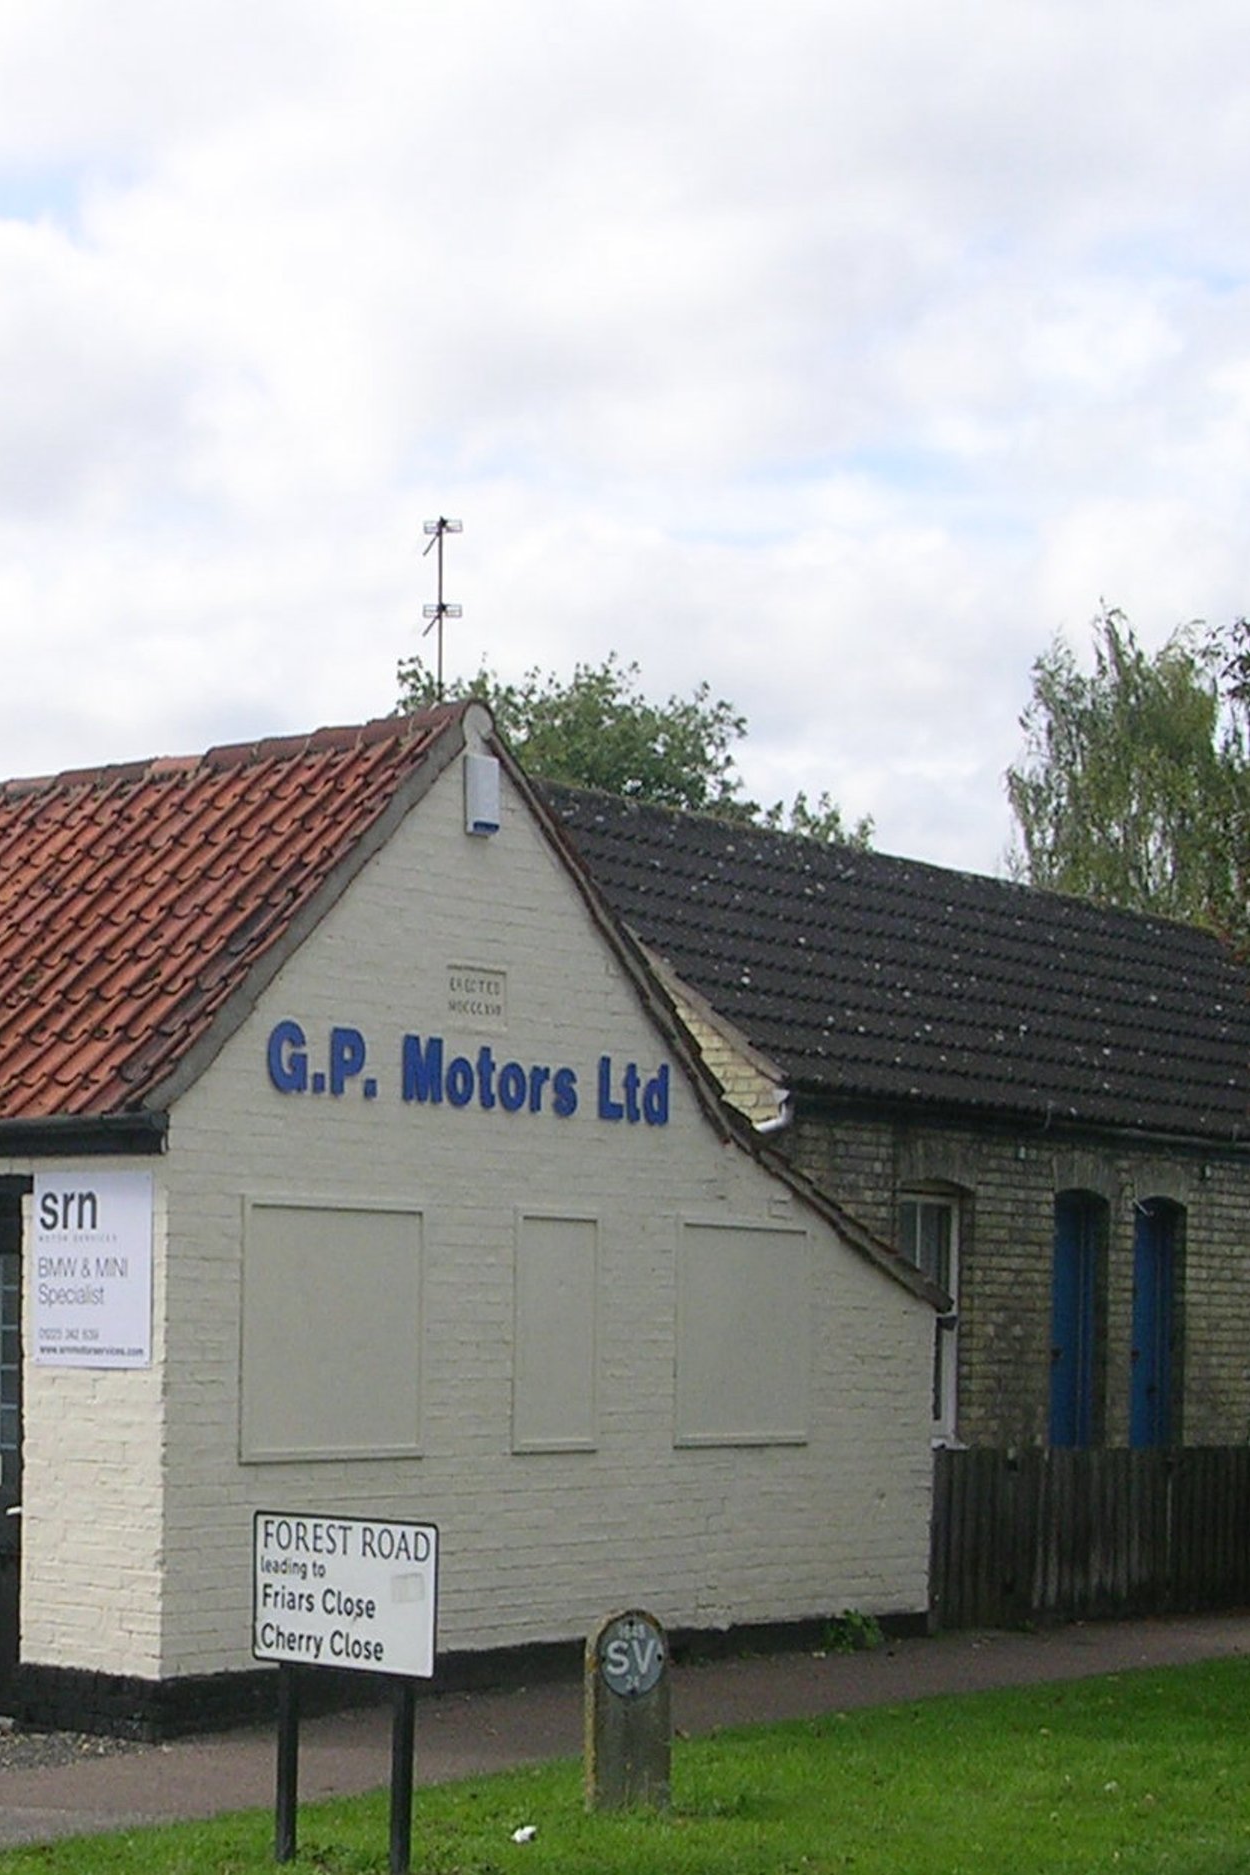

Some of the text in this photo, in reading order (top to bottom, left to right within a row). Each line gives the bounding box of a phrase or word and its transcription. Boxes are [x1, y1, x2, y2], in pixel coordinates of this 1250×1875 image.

[267, 1020, 670, 1126] G.P. Motors Ltd
[39, 1190, 97, 1230] srn
[38, 1257, 129, 1279] BMW & MINI
[38, 1283, 105, 1308] Specialist
[263, 1520, 431, 1562] FOREST ROAD
[260, 1556, 326, 1580] leading to
[262, 1583, 376, 1619] Friars Close
[261, 1623, 384, 1662] Cherry Close
[606, 1640, 655, 1675] SV
